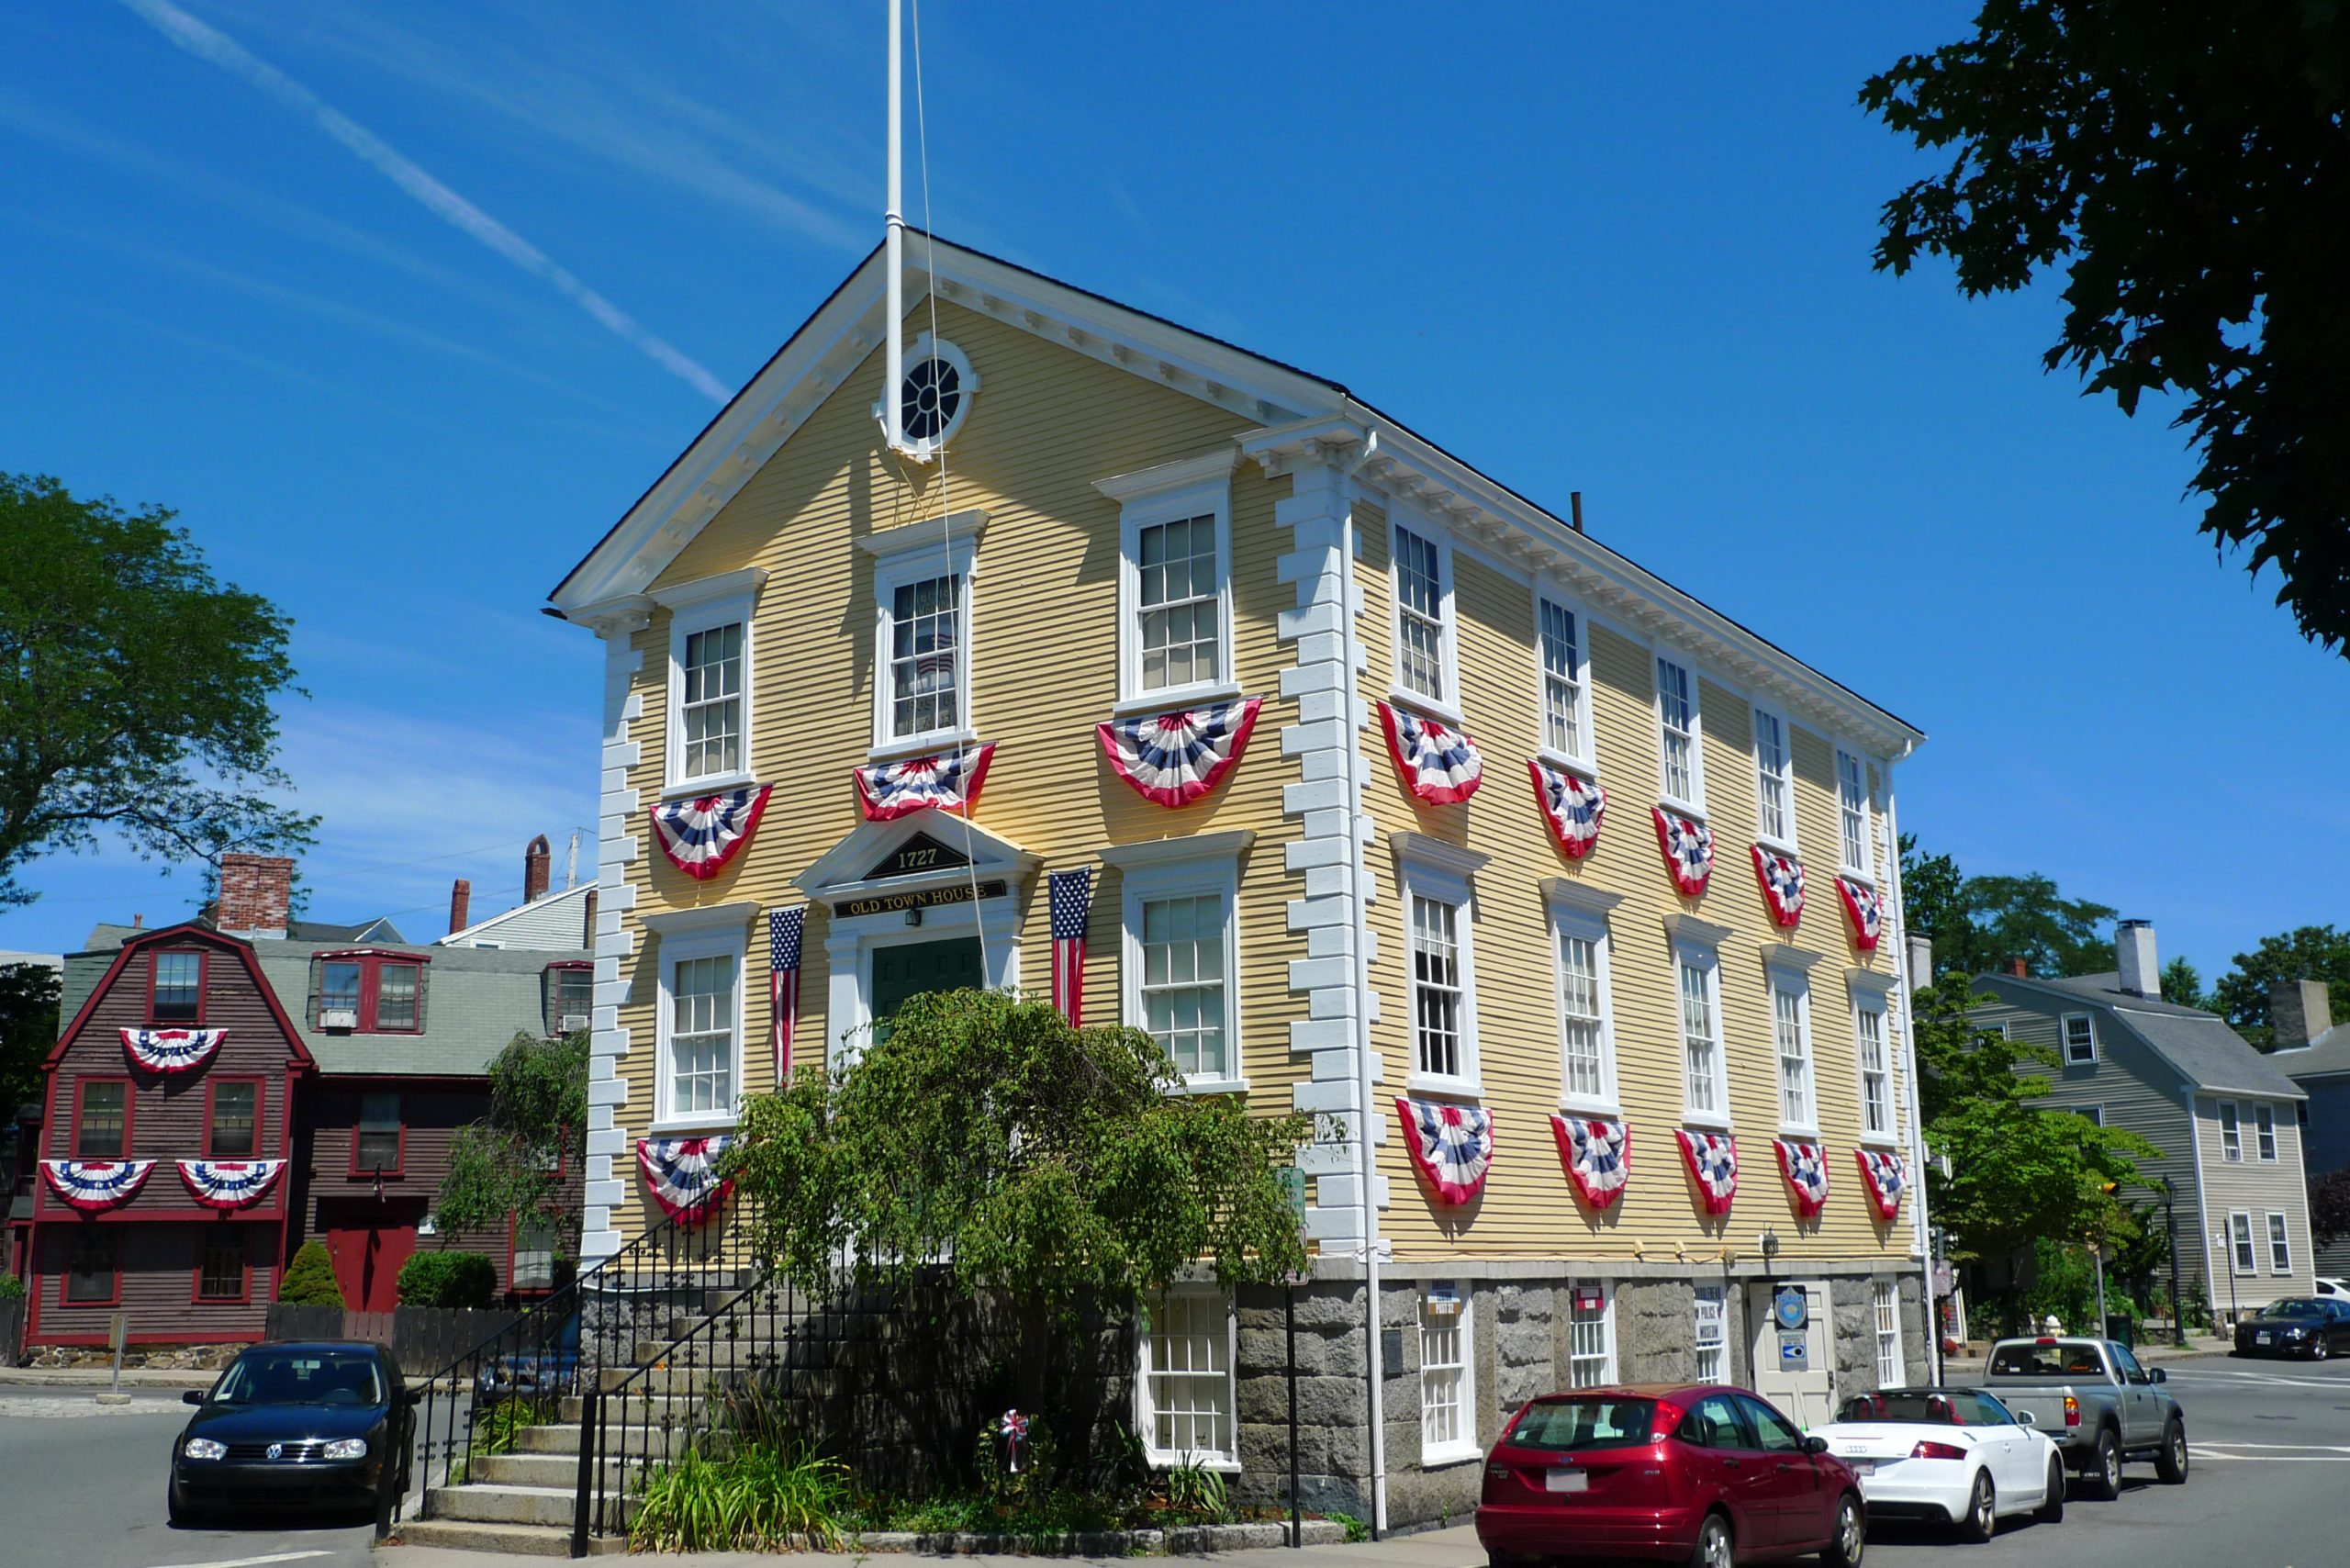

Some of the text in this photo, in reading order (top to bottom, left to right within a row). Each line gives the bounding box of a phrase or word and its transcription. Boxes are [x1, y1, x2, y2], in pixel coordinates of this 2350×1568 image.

[899, 848, 937, 868] 1727
[850, 885, 987, 914] OLD TOWN HOUSE
[1700, 1306, 1716, 1319] POLICE
[1699, 1325, 1718, 1338] MUSEUM
